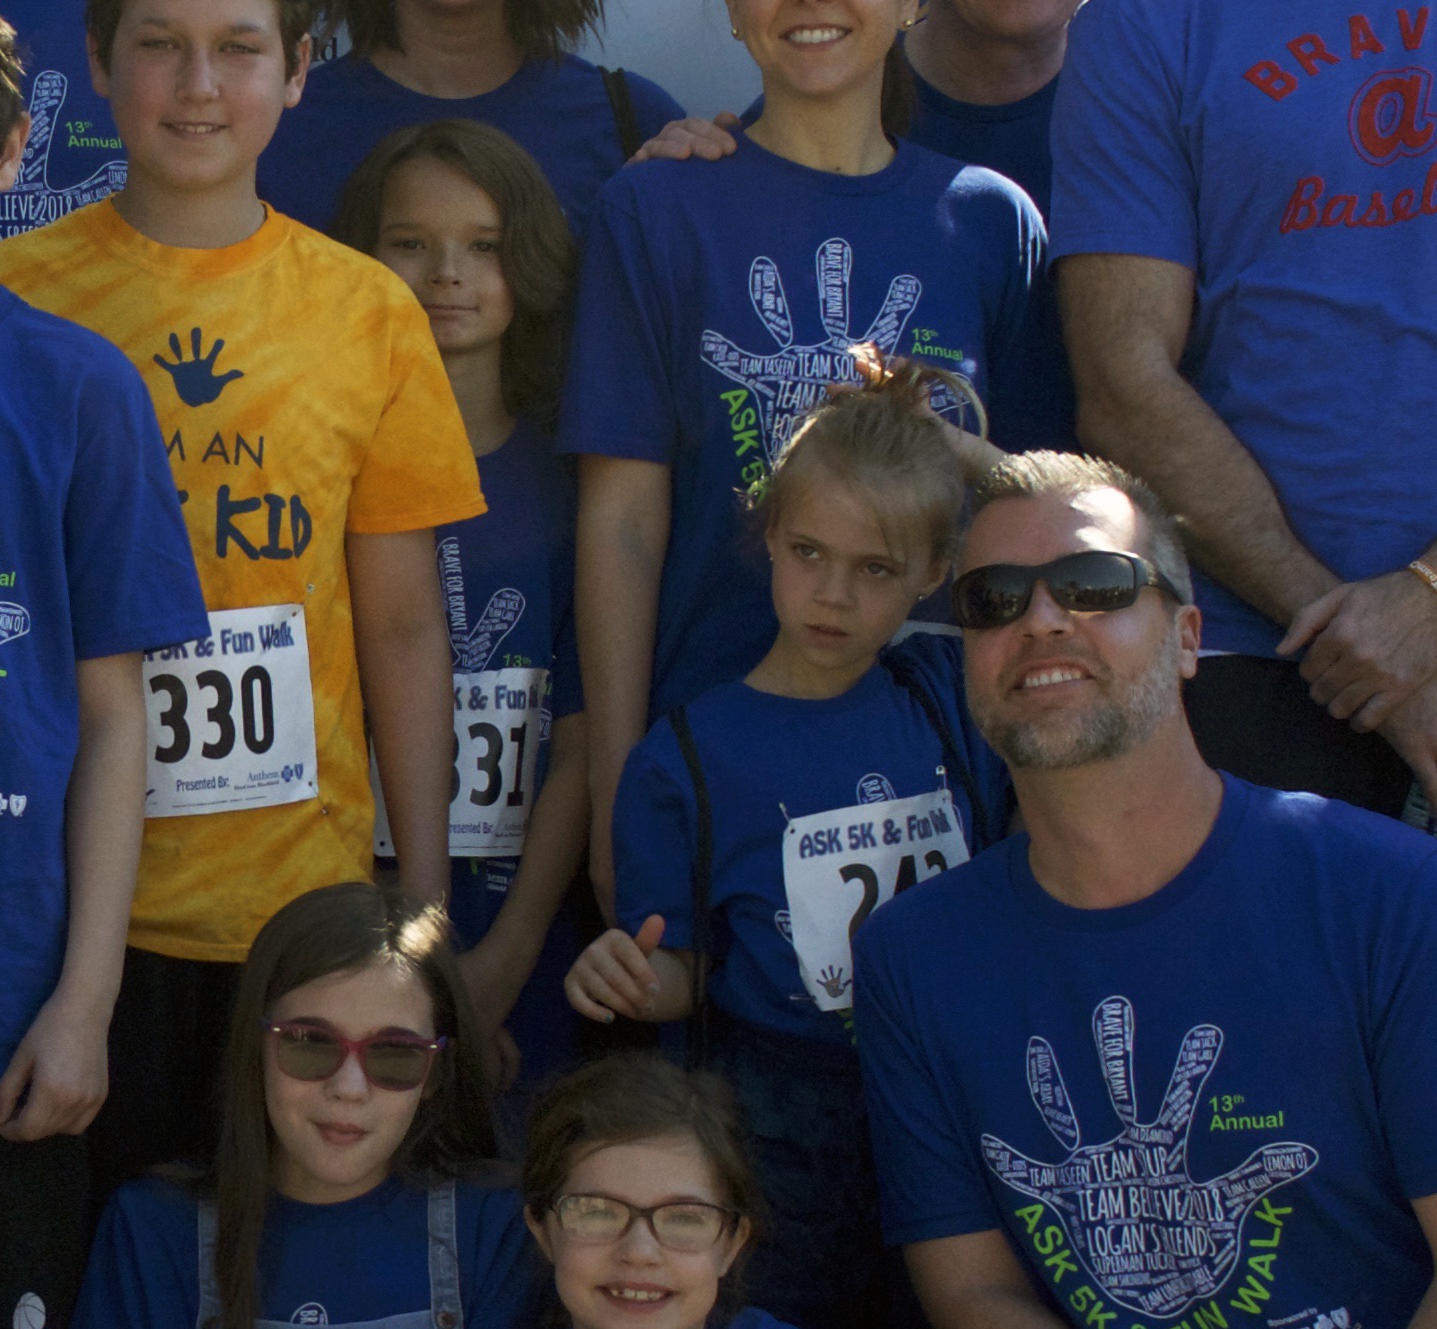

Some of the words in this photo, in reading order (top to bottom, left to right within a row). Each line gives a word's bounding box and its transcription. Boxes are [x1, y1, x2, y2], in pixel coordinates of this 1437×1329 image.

[68, 136, 123, 149] Annual
[797, 353, 829, 377] TEAM
[912, 342, 963, 361] Annual
[201, 432, 265, 470] AN
[216, 484, 313, 561] KID
[220, 626, 255, 656] Fun
[258, 620, 295, 649] Walk
[148, 664, 275, 764] 330
[799, 826, 843, 859] ASK
[847, 822, 877, 850] 5K
[882, 819, 902, 845] &
[1208, 1094, 1244, 1113] 13th
[1209, 1112, 1285, 1132] Annual
[1077, 1189, 1125, 1222] TEAM
[1014, 1203, 1078, 1283] ASK
[1230, 1198, 1293, 1314] WALK
